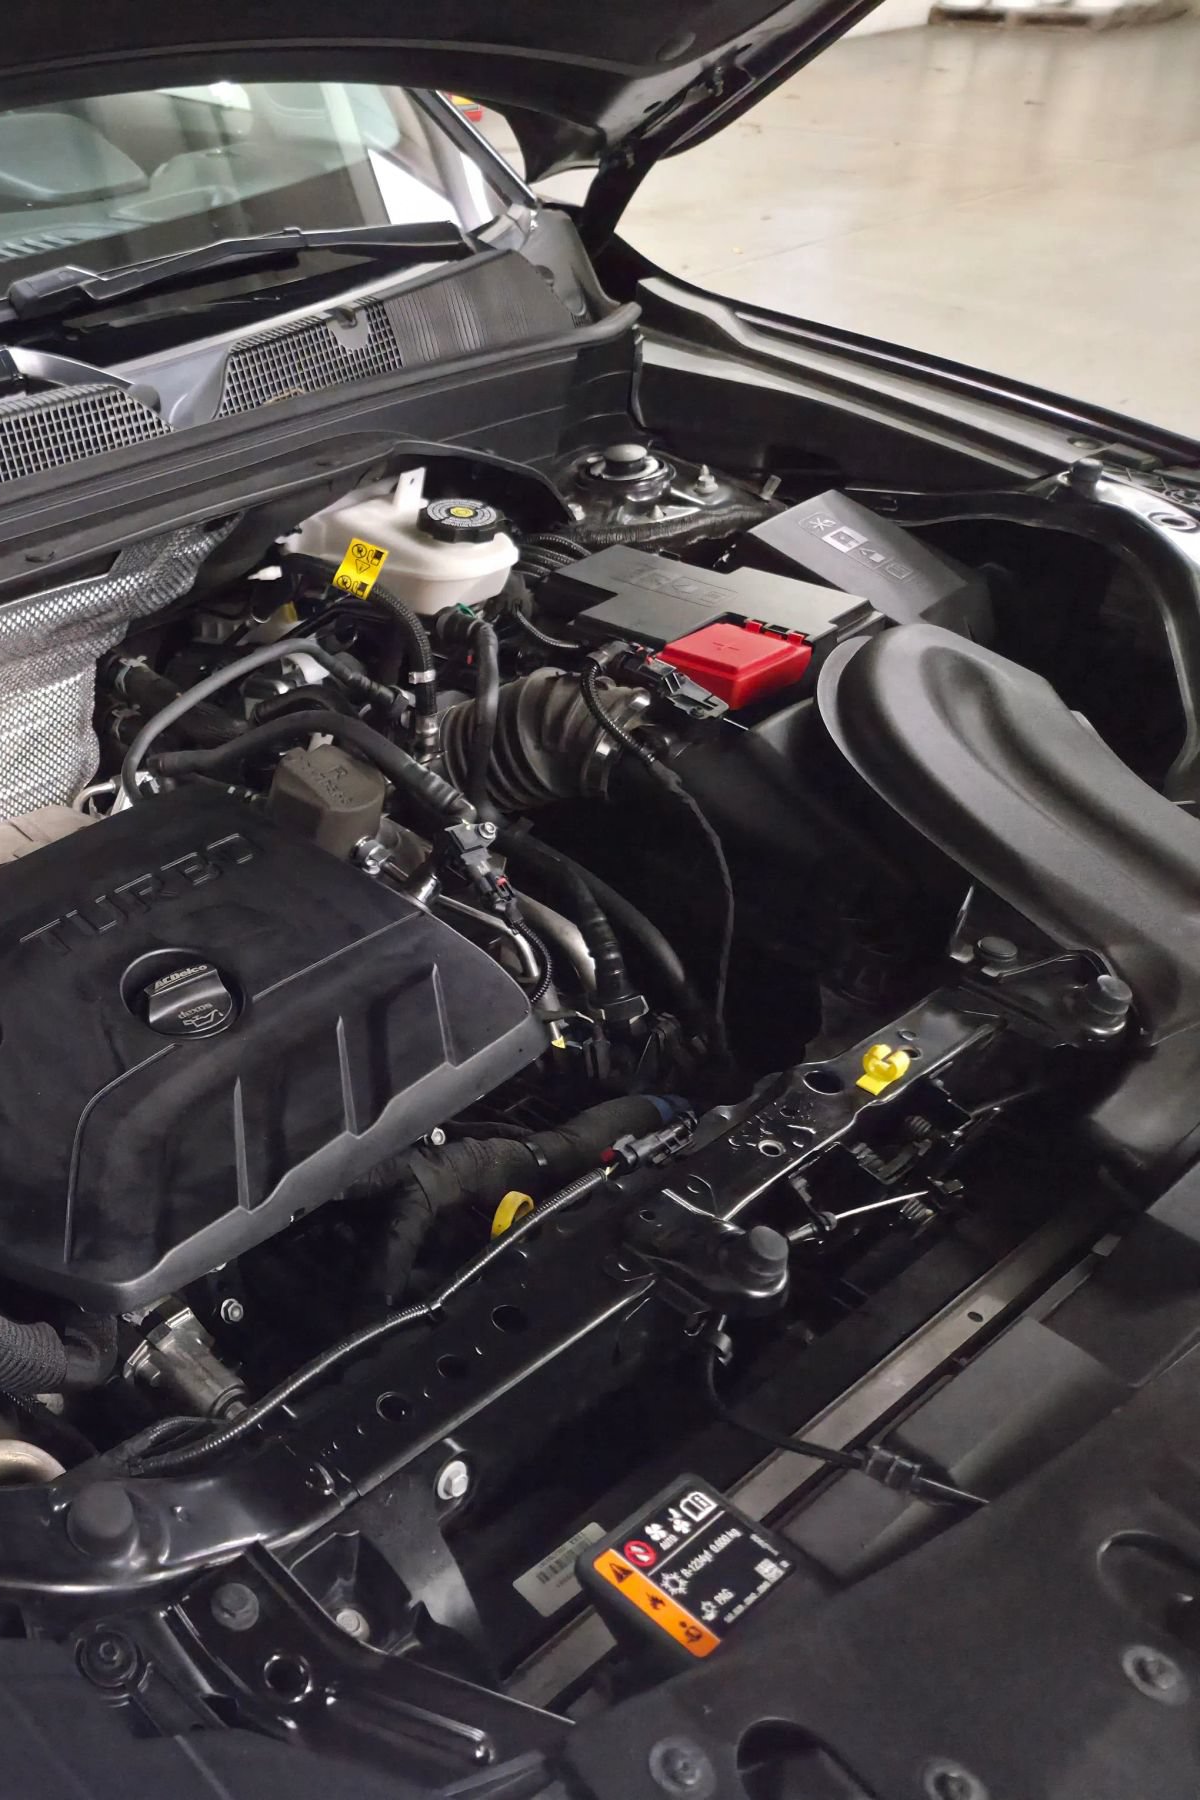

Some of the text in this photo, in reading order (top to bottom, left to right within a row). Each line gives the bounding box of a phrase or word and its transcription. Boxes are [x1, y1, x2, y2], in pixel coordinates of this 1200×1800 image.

[19, 833, 264, 955] TURBO
[154, 965, 208, 990] ACDelco
[659, 1534, 678, 1550] AUTO
[713, 1588, 734, 1605] PAG
